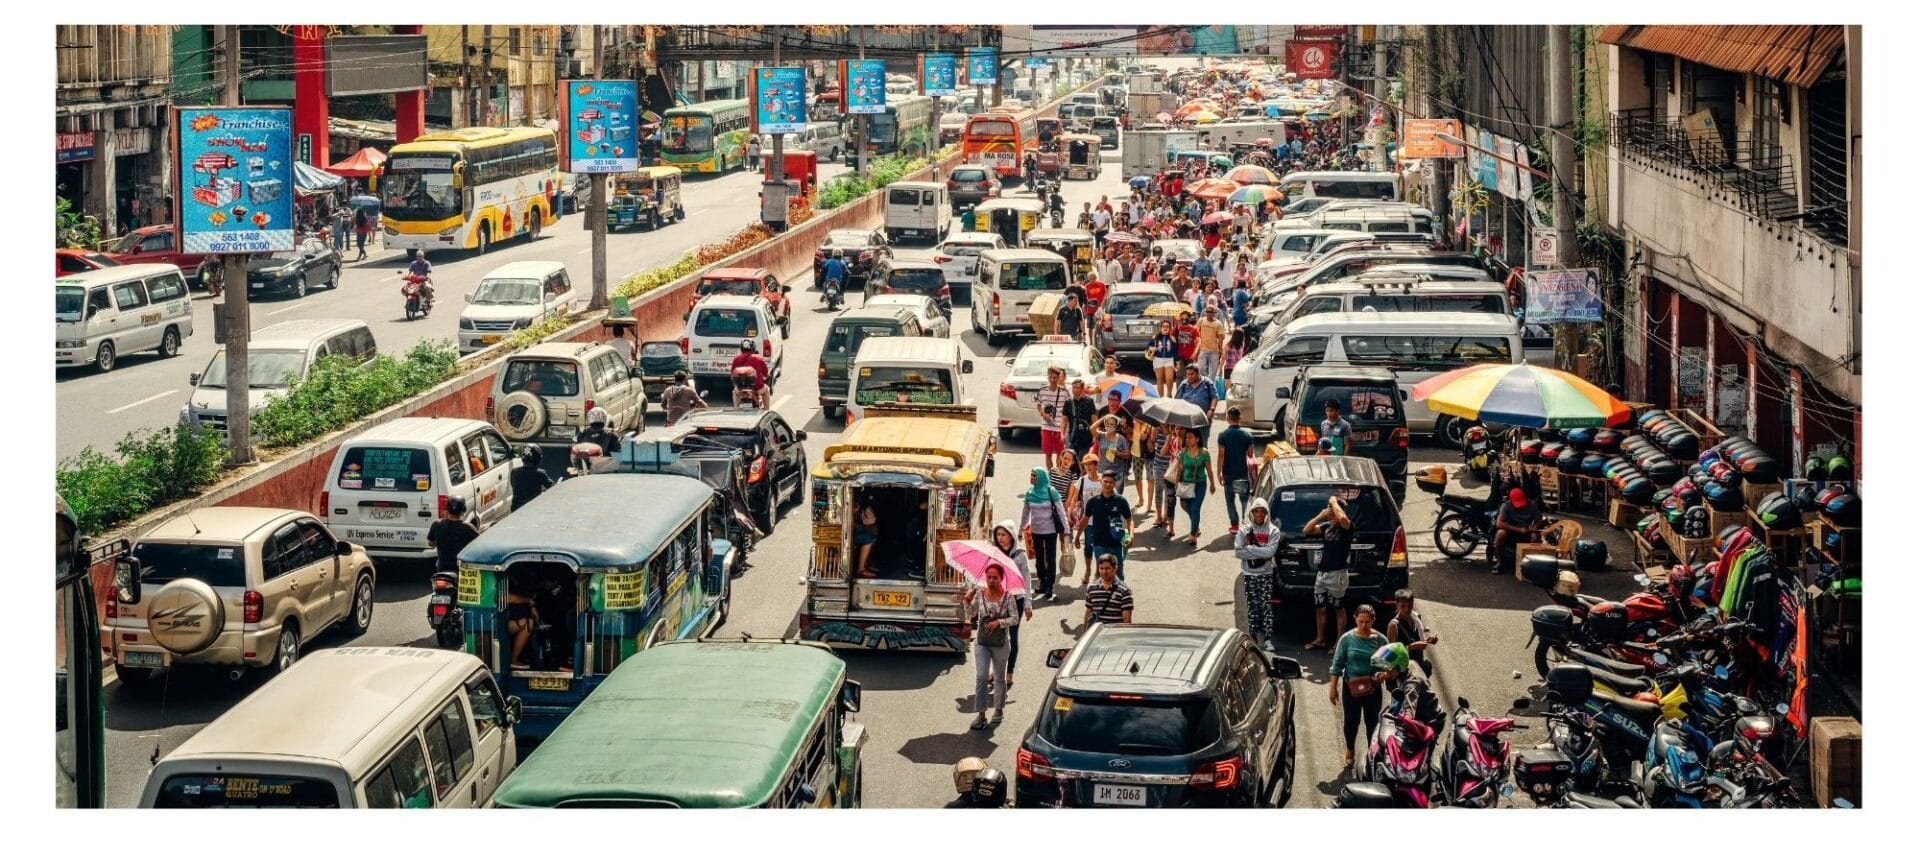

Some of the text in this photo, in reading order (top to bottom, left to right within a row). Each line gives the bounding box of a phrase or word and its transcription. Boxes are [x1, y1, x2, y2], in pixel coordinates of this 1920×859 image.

[221, 119, 280, 129] Franchise
[355, 529, 375, 540] Express
[375, 530, 394, 539] Service
[226, 777, 259, 792] BENTE
[225, 791, 258, 799] QUATRO
